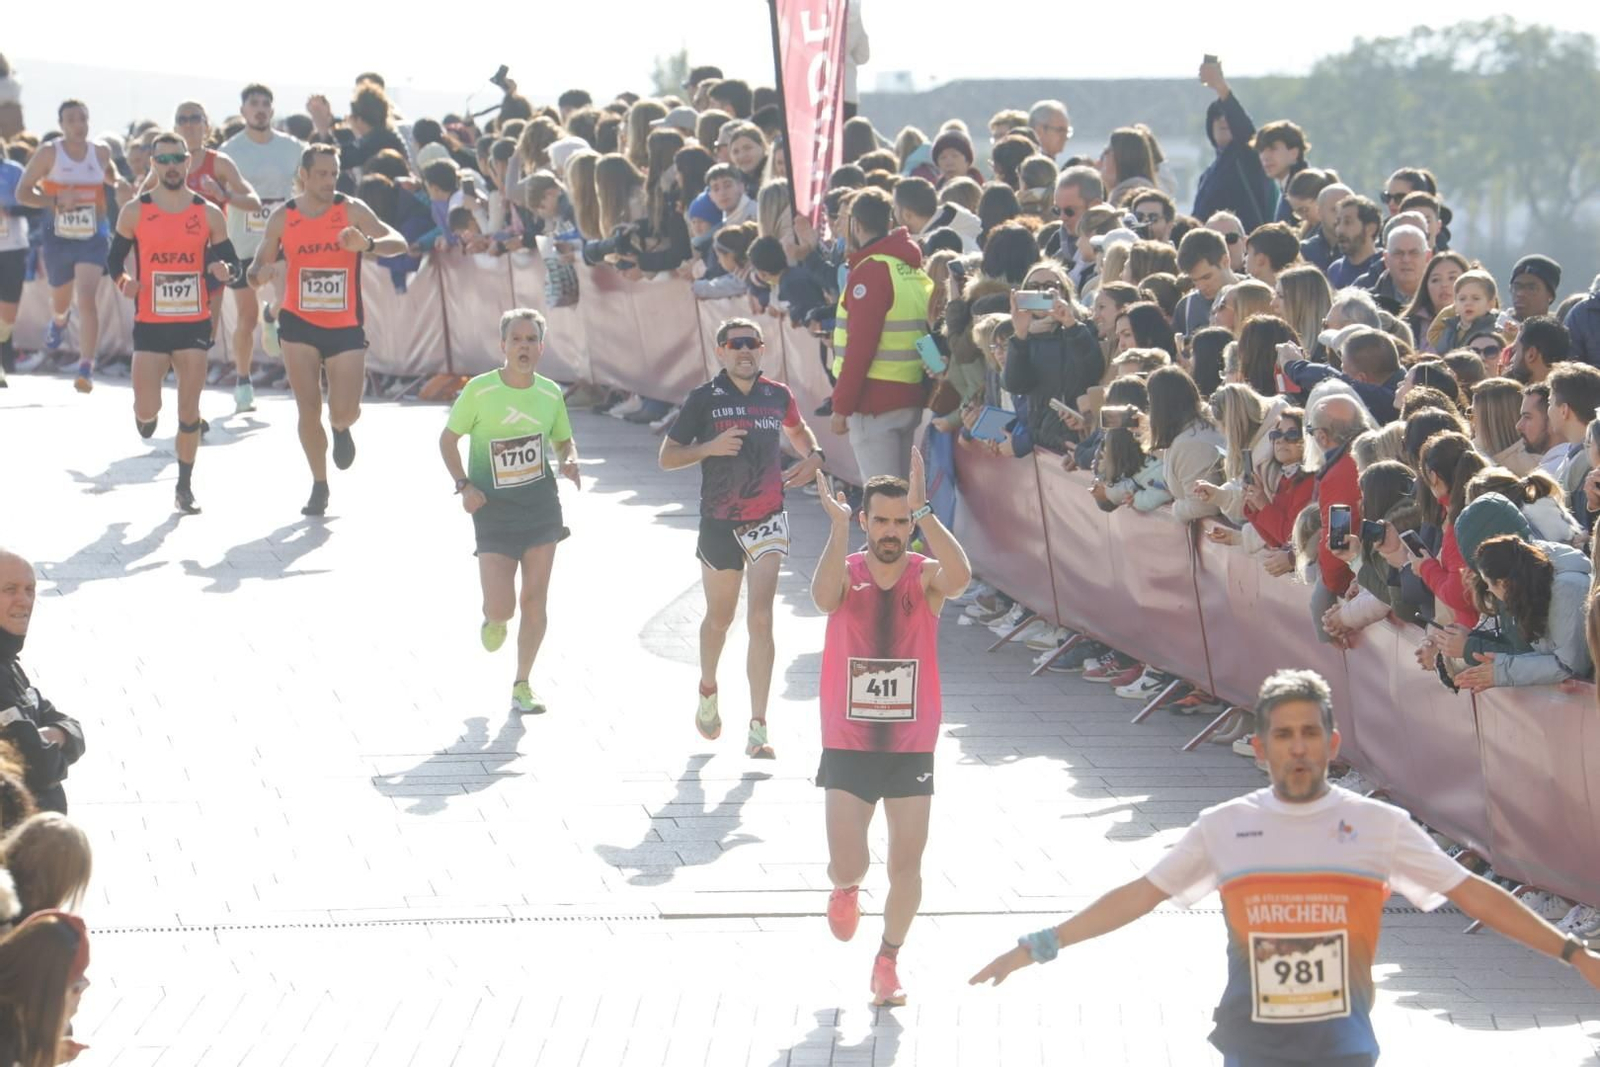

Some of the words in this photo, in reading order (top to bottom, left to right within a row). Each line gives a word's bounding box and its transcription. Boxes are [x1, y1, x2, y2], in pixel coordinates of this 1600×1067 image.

[63, 214, 89, 226] 1914
[298, 242, 341, 254] ASFAS
[150, 252, 196, 264] ASFAS
[162, 284, 192, 298] 1197
[306, 281, 340, 294] 1201
[712, 407, 734, 418] CLUB
[735, 406, 747, 416] DE
[500, 448, 536, 467] 1710
[747, 521, 783, 541] 924
[866, 678, 898, 697] 411
[1246, 904, 1348, 925] MARCHENA
[1274, 959, 1325, 985] 981
